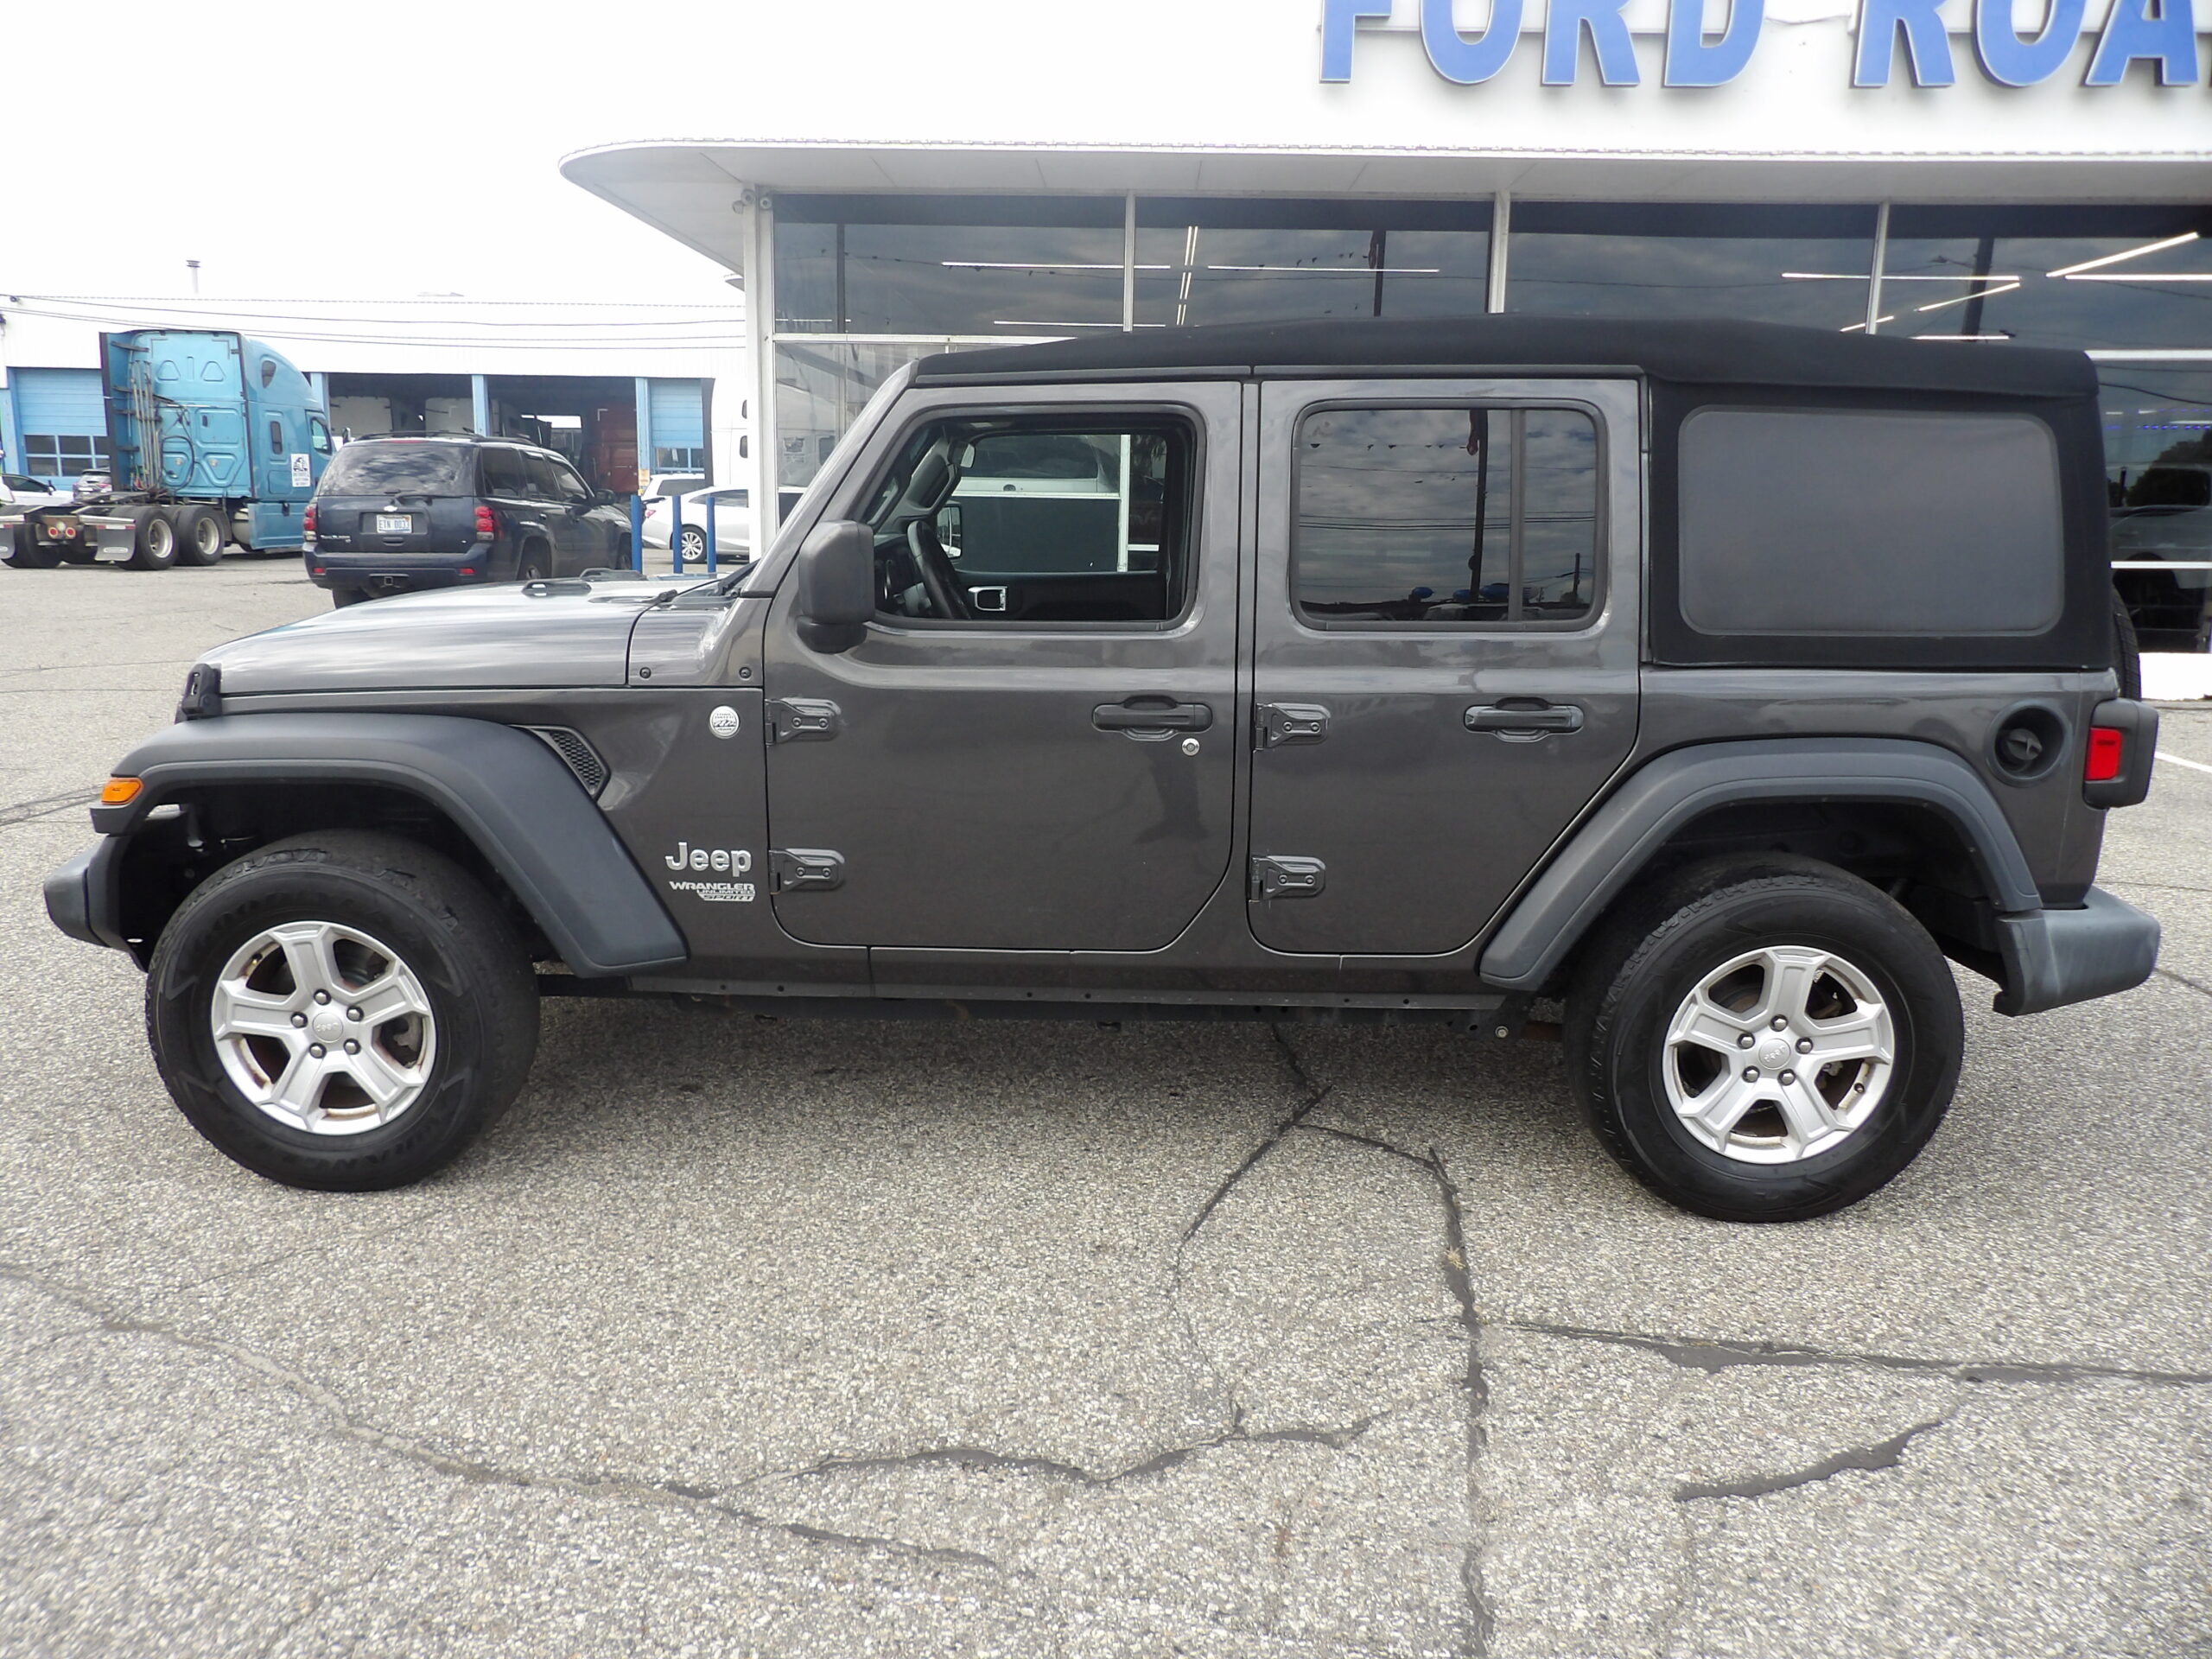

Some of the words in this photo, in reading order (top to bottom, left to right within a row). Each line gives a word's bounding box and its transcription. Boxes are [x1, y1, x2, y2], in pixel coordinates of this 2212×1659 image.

[1319, 0, 1765, 86] FORD
[1853, 0, 2212, 86] ROA
[665, 842, 752, 877] Jeep
[669, 881, 755, 890] WRANGLER
